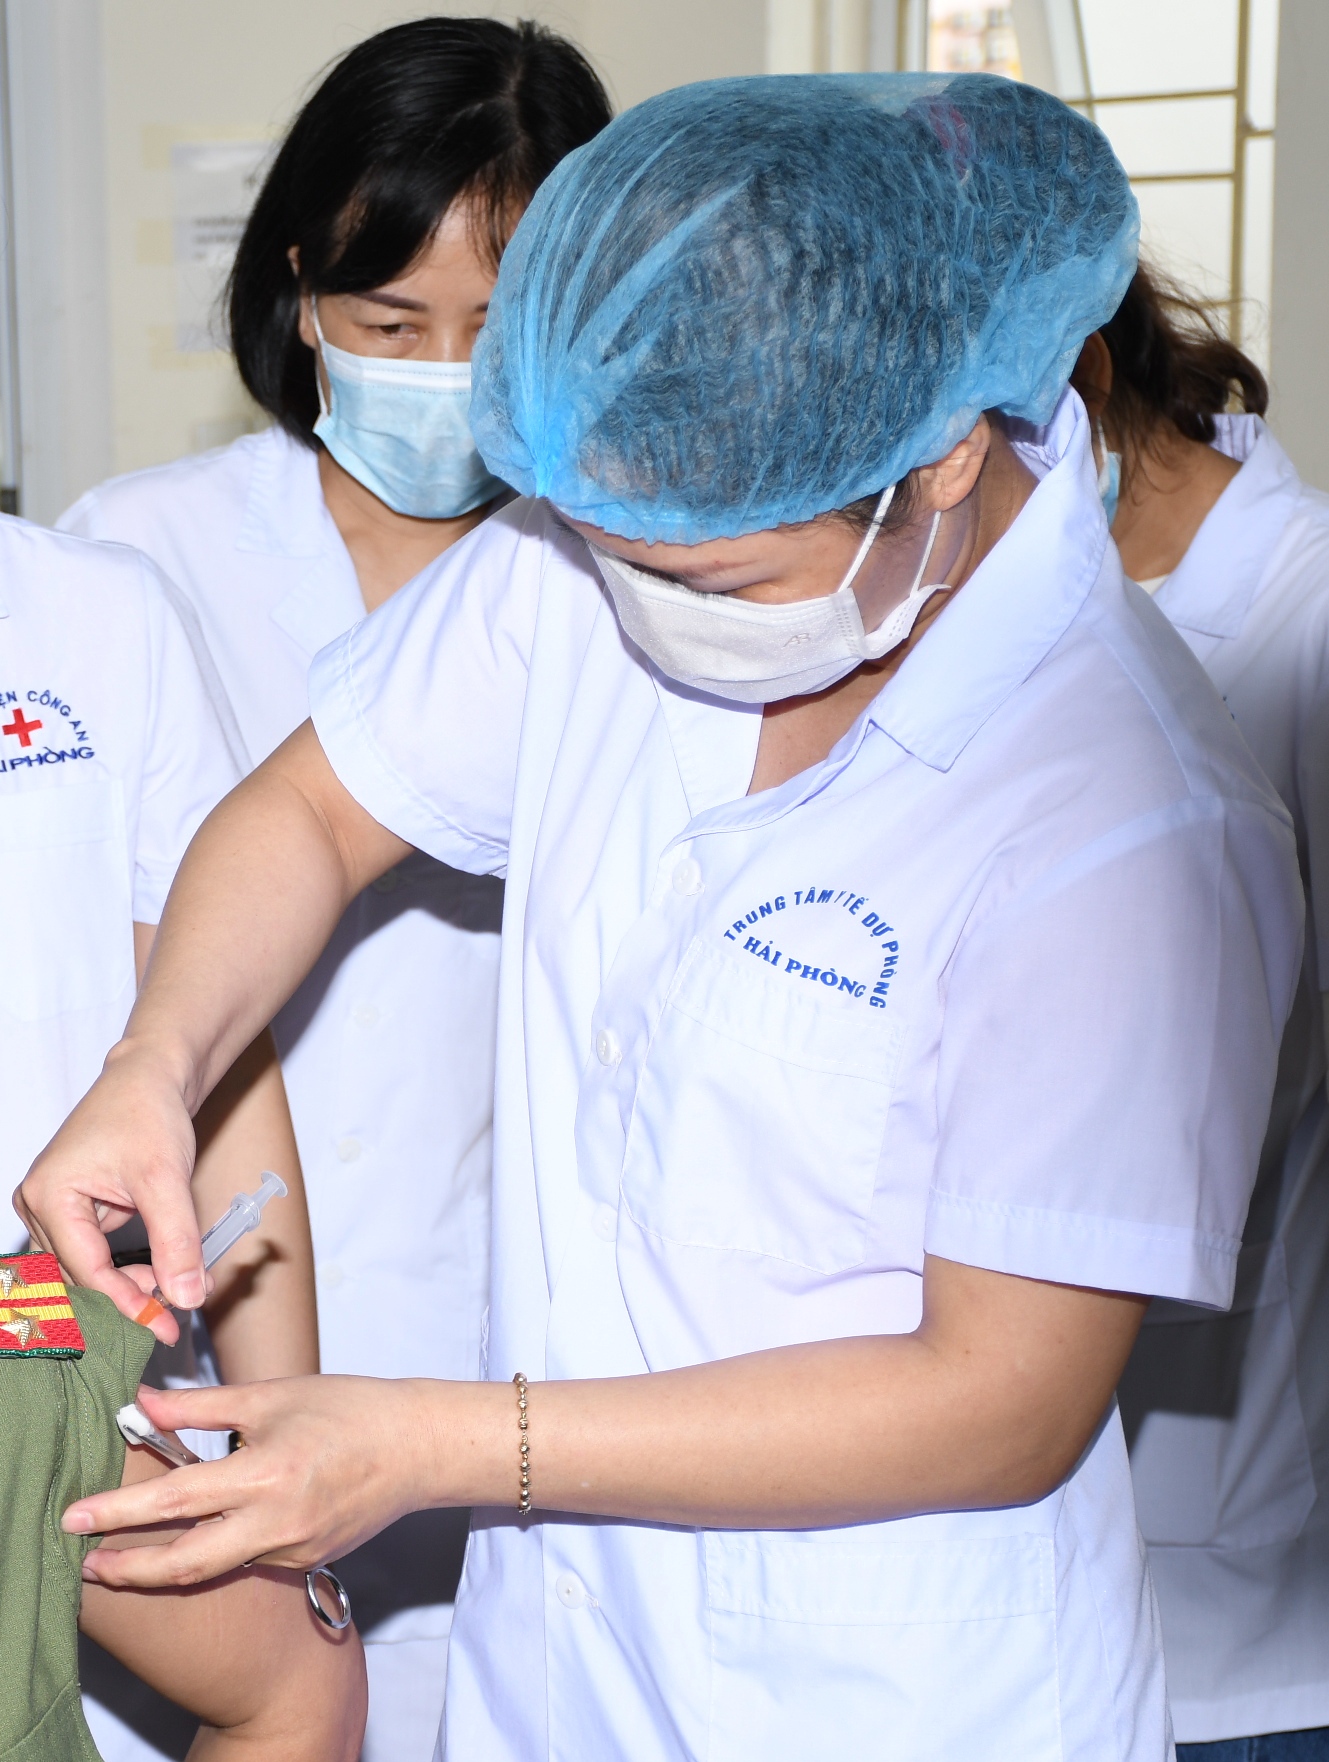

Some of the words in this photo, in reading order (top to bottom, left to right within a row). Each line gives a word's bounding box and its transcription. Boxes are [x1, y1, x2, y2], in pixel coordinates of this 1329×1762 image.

[27, 689, 71, 717] CÔNG
[69, 720, 89, 742] AN
[9, 746, 95, 771] PHÒNG
[723, 895, 787, 941] TRUNG
[794, 886, 835, 905] TÂM
[861, 912, 894, 938] DỰ
[742, 936, 782, 966] HẢI
[784, 957, 867, 998] PHÒNG
[869, 940, 899, 1009] PHÒNG
